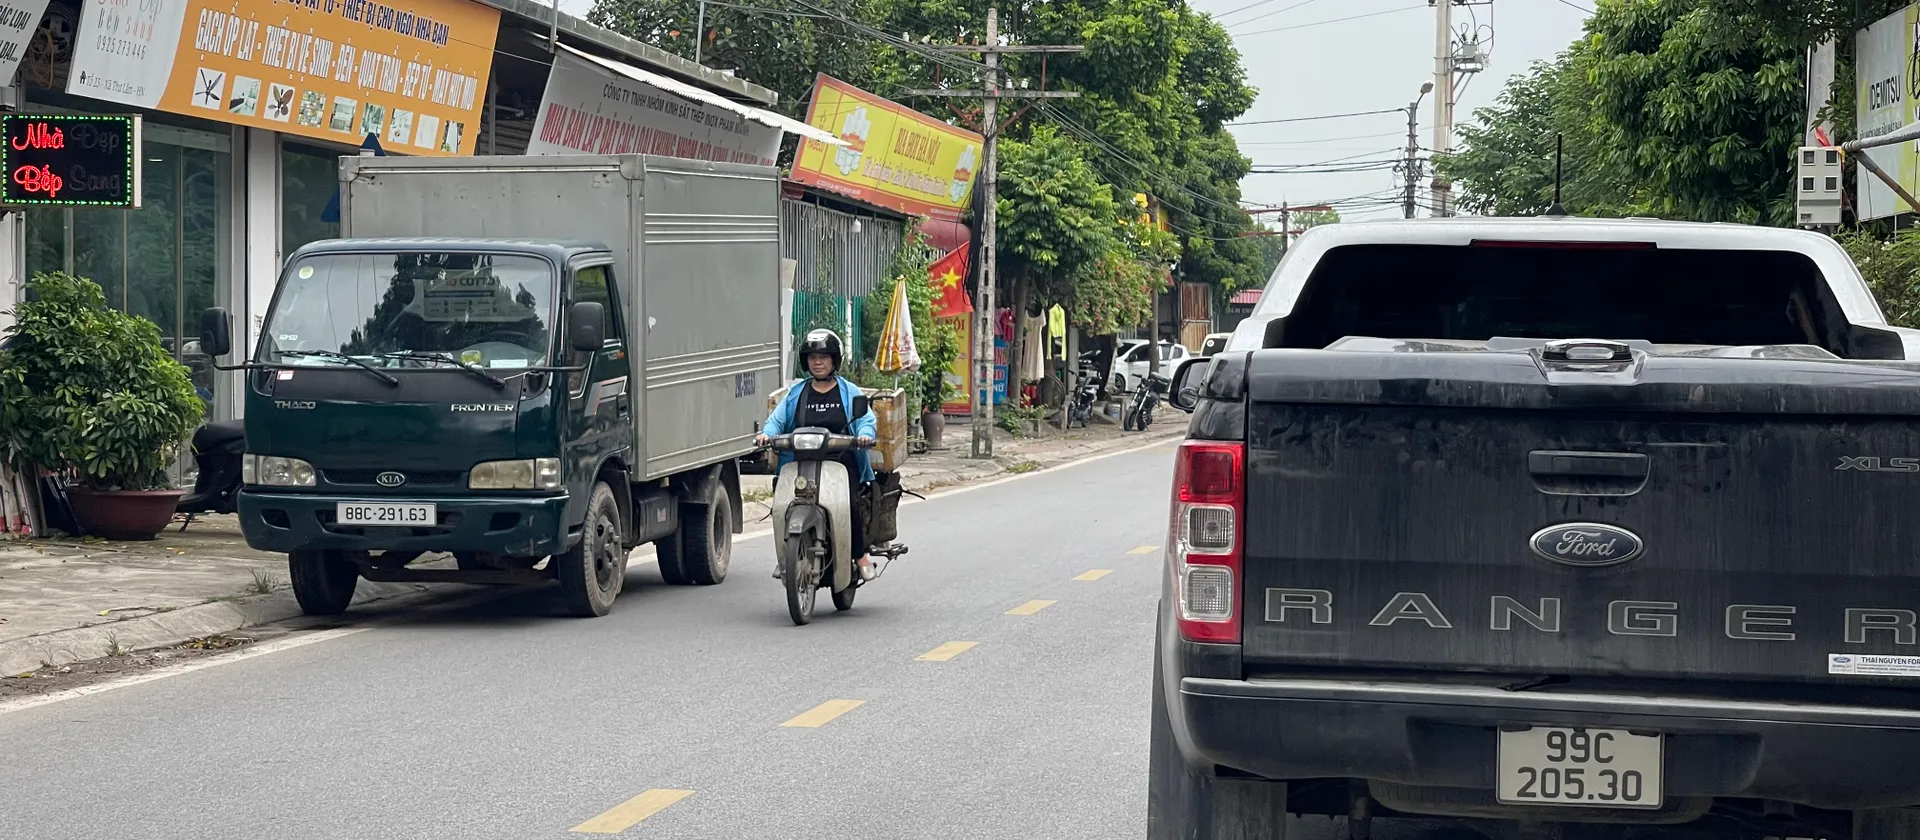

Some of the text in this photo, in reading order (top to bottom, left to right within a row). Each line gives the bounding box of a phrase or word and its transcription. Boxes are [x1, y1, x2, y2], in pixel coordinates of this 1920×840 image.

[9, 9, 31, 33] LOẠI
[366, 3, 377, 31] BỊ
[376, 6, 395, 30] CHO
[394, 10, 416, 36] NGÔI
[431, 22, 450, 49] BẠN
[195, 8, 226, 61] GẠCH
[223, 1, 241, 57] ỐP
[236, 12, 260, 62] LÁT
[261, 16, 291, 68] THIẾT
[309, 37, 334, 79] SINH
[357, 49, 382, 97] QUẠT
[603, 82, 621, 101] CÔNG
[622, 89, 631, 104] TY
[630, 90, 648, 109] TNHH
[1869, 75, 1901, 111] IDEMITSU
[12, 122, 65, 151] Nhà
[540, 102, 569, 146] MUA
[13, 164, 63, 198] Bếp
[274, 400, 317, 410] THACO
[450, 403, 515, 413] FRONTIER
[345, 506, 428, 521] 88C-291.63
[1555, 530, 1617, 556] Ford
[1264, 586, 1918, 646] RANGER
[1861, 656, 1878, 664] THAI
[1878, 657, 1907, 665] NGUYEN
[1546, 730, 1615, 764] 99C
[1516, 766, 1642, 802] 205.30
